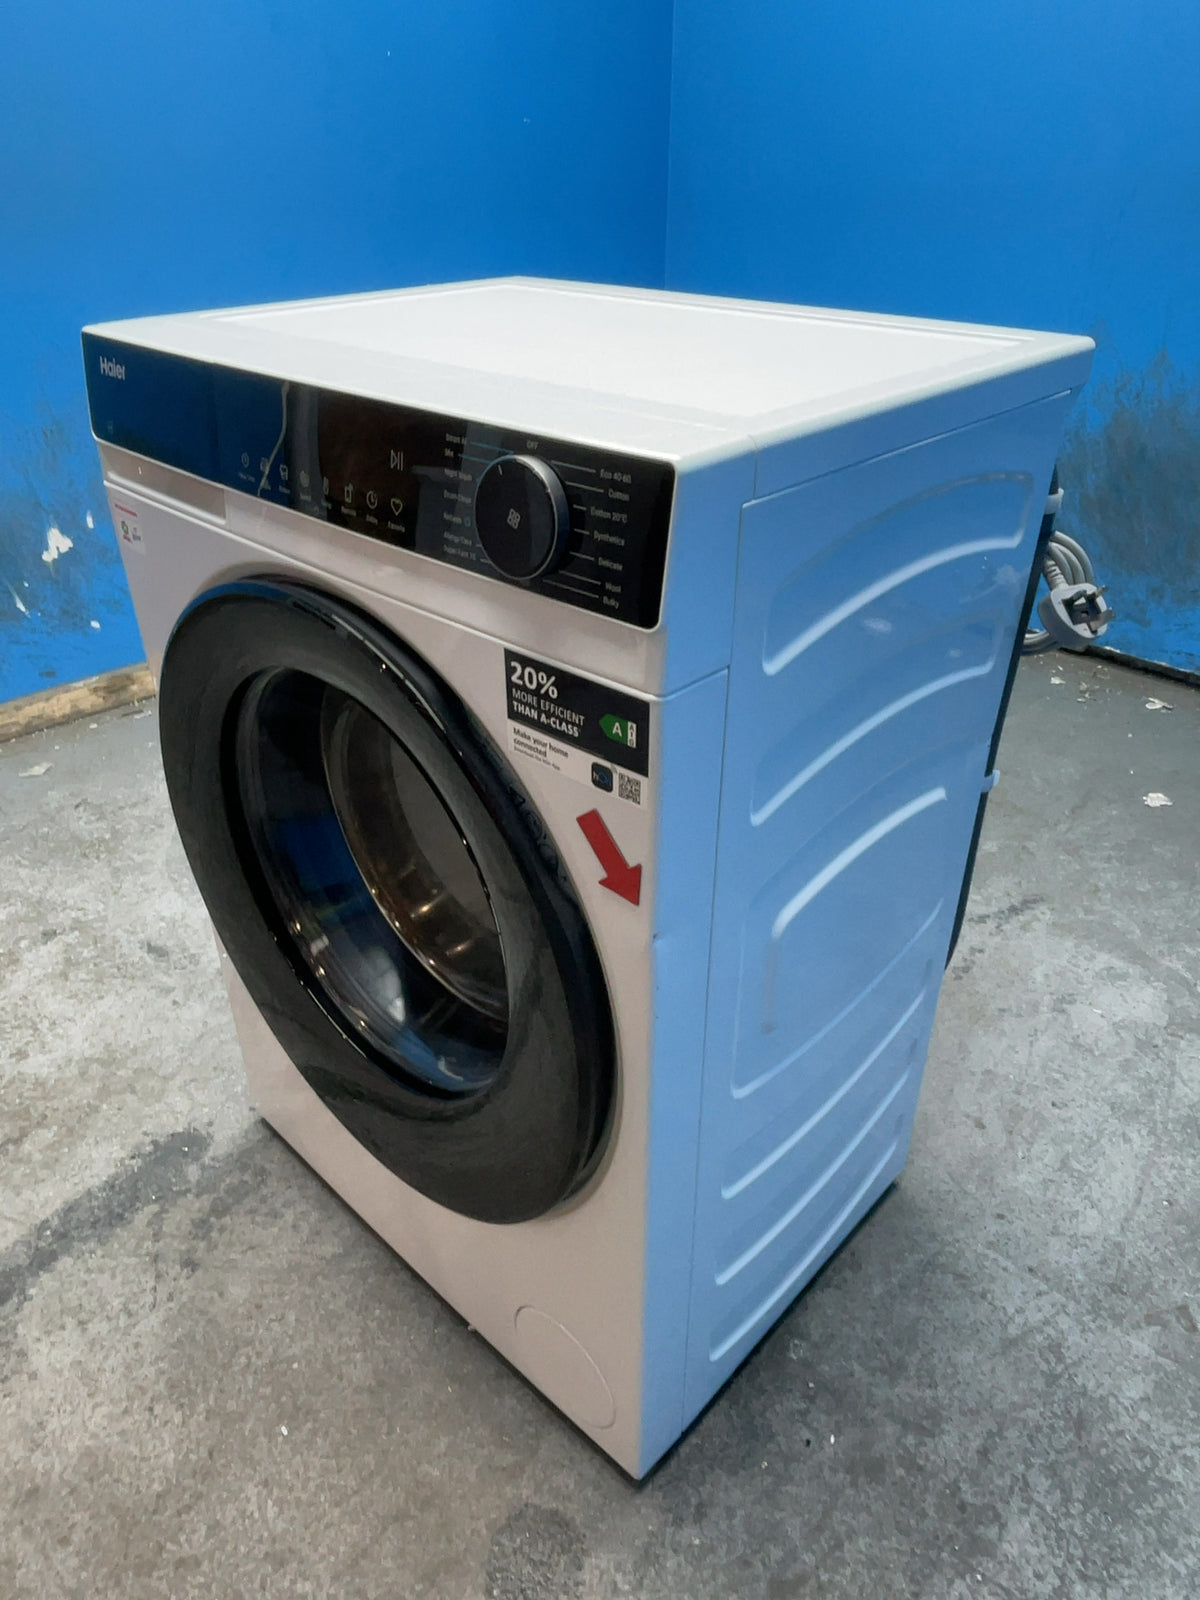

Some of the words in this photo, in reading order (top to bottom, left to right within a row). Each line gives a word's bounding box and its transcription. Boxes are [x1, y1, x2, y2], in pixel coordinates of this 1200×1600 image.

[99, 355, 125, 381] Haier
[526, 440, 539, 450] OFF
[599, 468, 612, 479] Eco
[608, 488, 630, 502] Cotton
[598, 557, 623, 572] Delicate
[605, 582, 621, 592] Wool
[602, 596, 619, 609] Bulky
[510, 661, 558, 699] 20%
[512, 688, 538, 706] MORE
[540, 699, 585, 727] EFFICIENT
[513, 701, 538, 720] THAN
[612, 722, 622, 737] A
[513, 727, 531, 741] Make
[532, 738, 547, 748] your
[549, 742, 569, 758] home
[513, 738, 547, 758] connected
